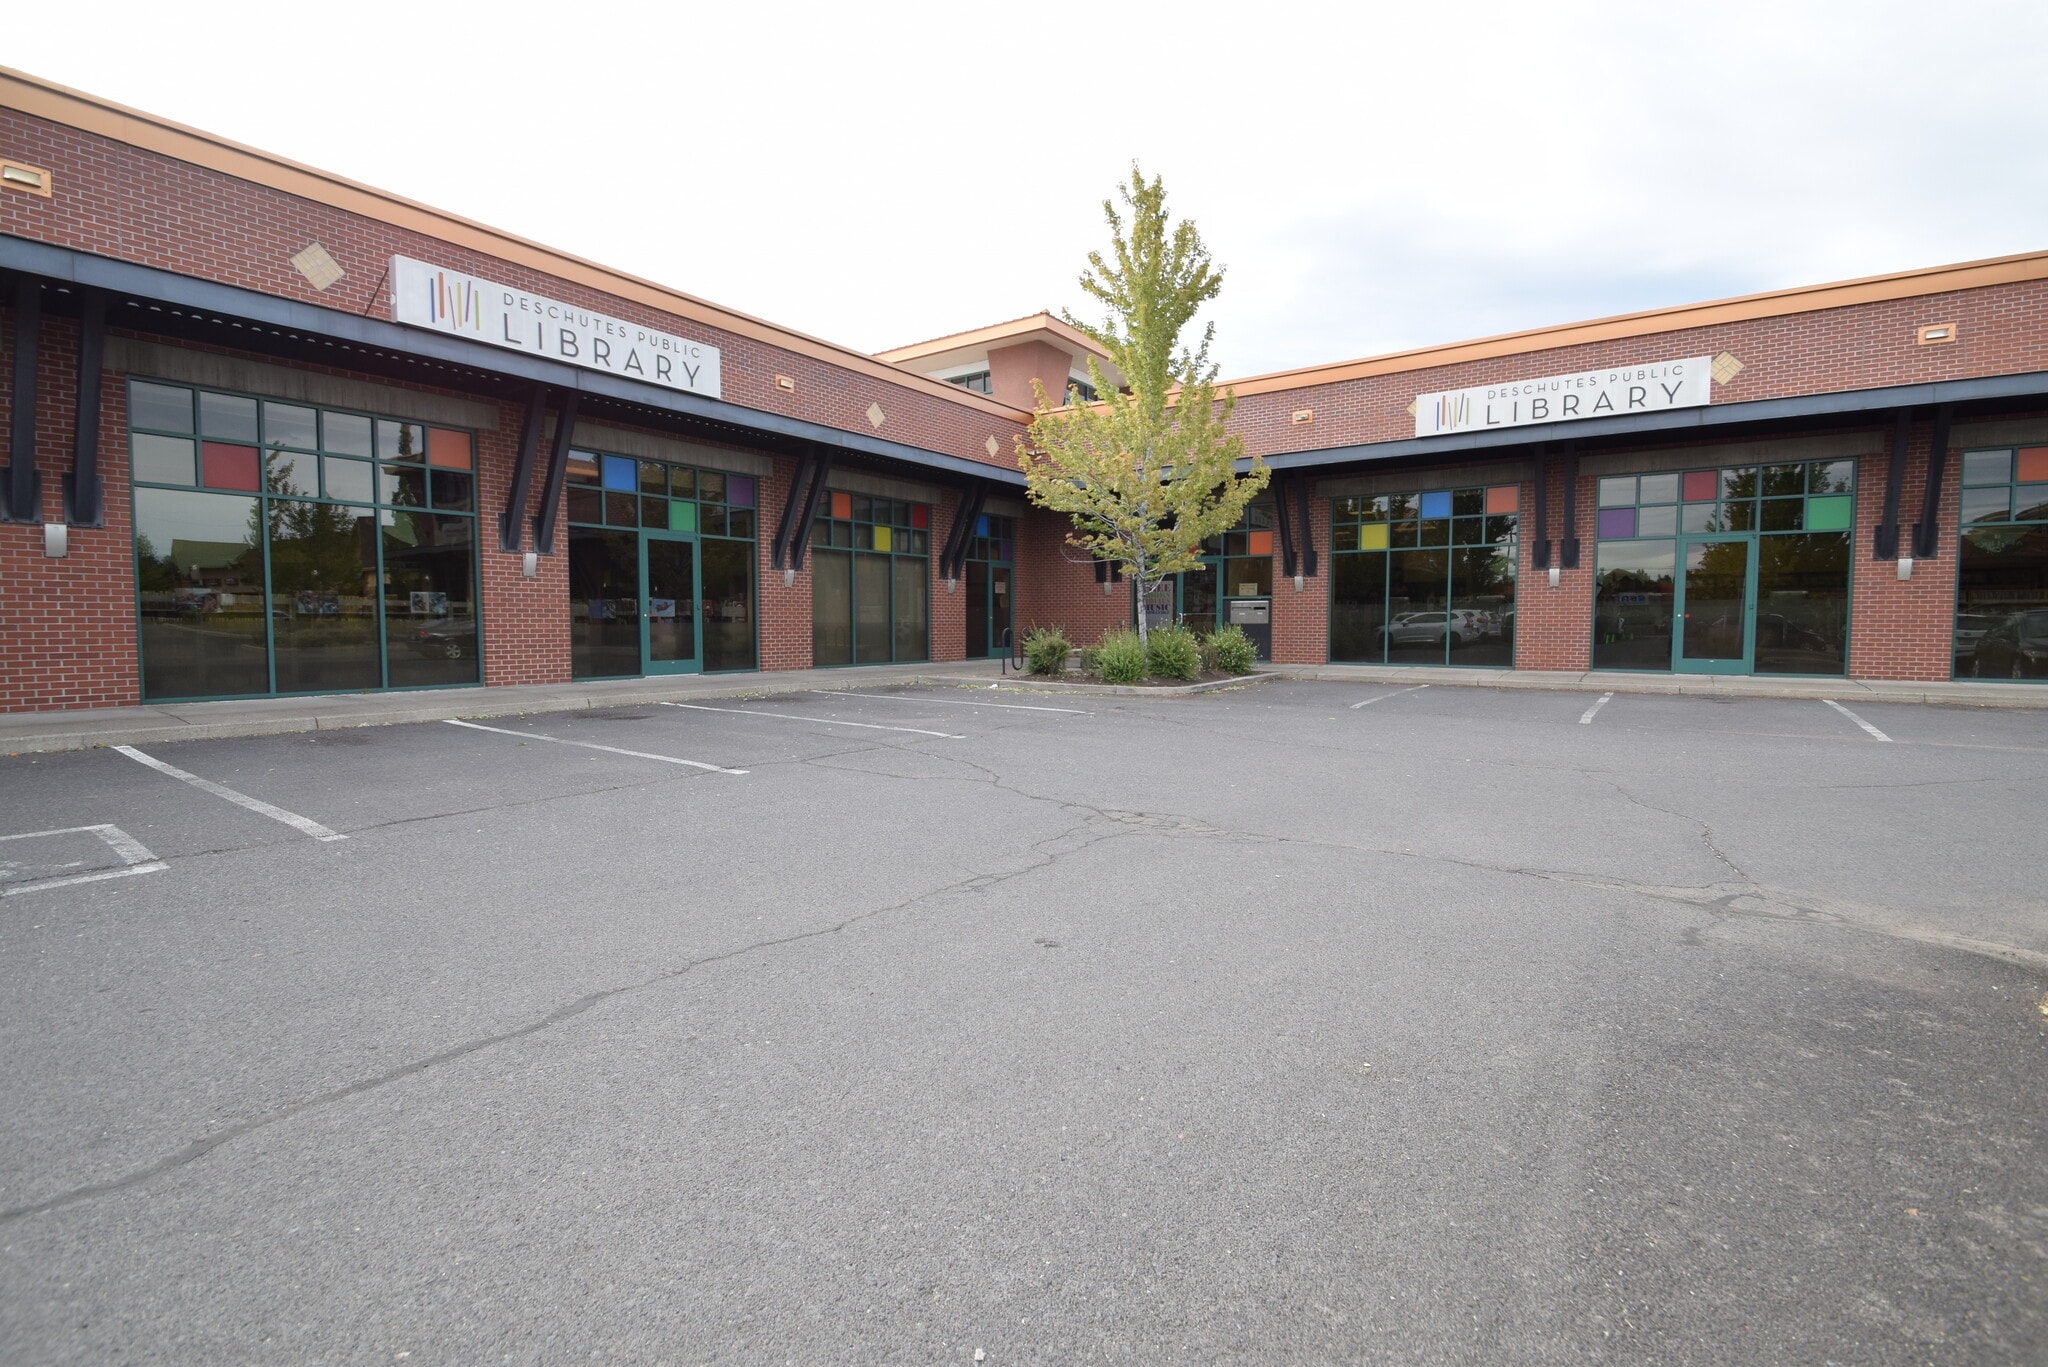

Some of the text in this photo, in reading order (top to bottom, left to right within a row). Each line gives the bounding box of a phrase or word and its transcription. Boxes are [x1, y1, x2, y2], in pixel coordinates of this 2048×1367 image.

[503, 293, 700, 358] DESCHUTES PUBLIC
[503, 312, 701, 388] LIBRARY
[1486, 380, 1684, 425] LIBRARY
[1487, 365, 1684, 400] DESCHUTES PUBLIC
